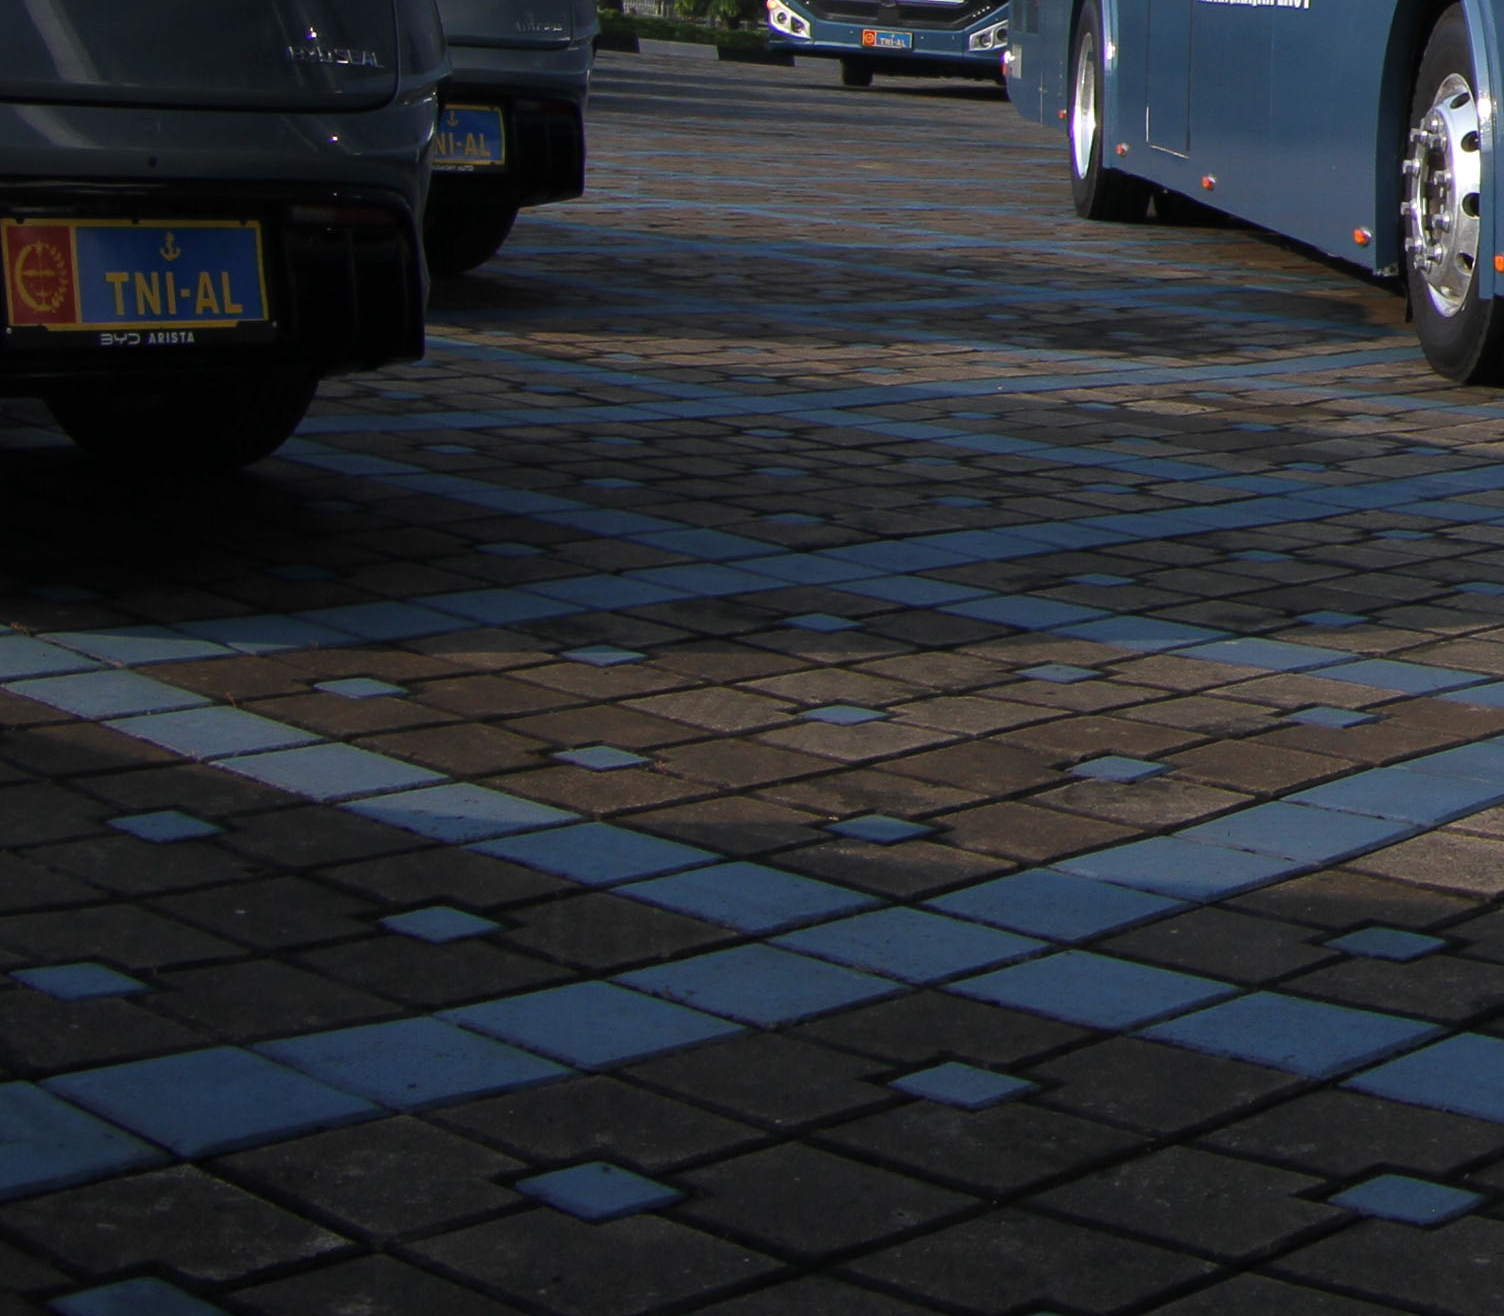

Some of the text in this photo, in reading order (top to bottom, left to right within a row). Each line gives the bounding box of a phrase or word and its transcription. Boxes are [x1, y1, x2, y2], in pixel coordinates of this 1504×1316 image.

[105, 271, 244, 316] TNI-AL
[100, 331, 196, 345] BYD ARISTA
